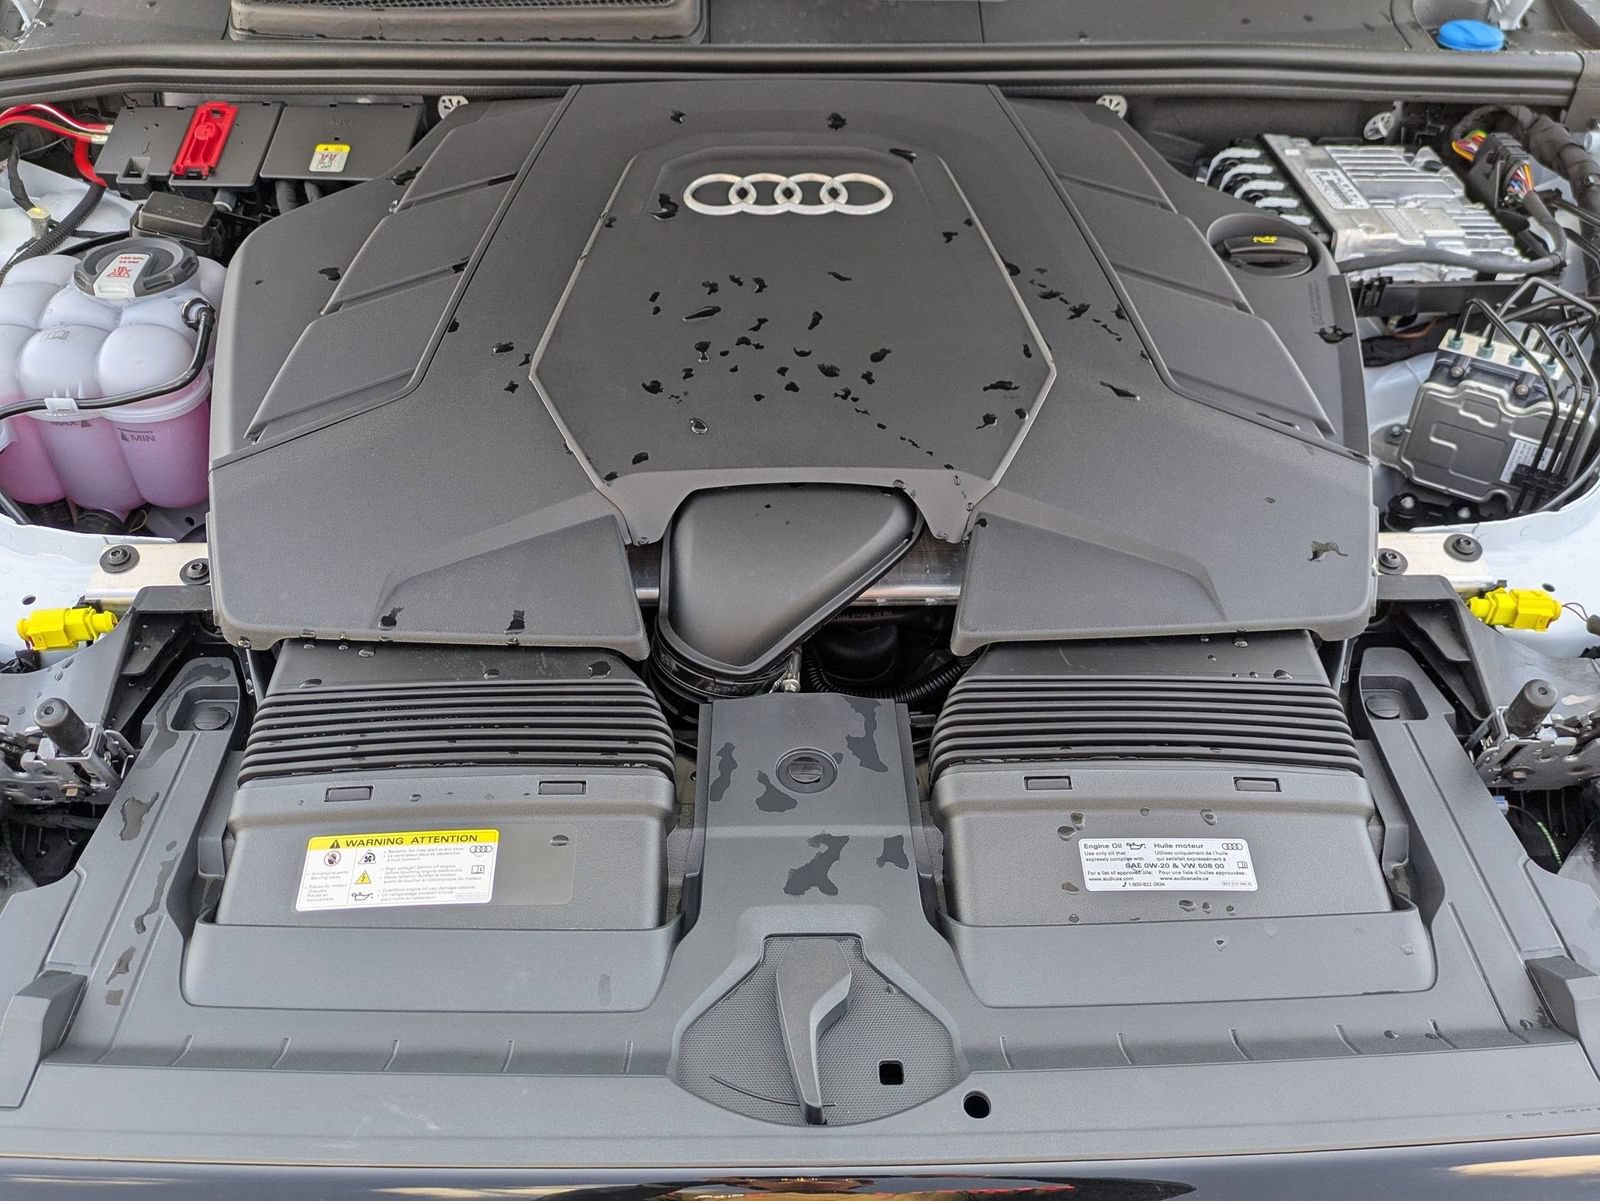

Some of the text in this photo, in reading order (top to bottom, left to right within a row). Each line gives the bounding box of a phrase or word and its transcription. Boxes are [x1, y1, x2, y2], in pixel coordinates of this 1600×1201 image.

[130, 434, 156, 442] MIN
[345, 835, 478, 847] WARNING ATTENTION
